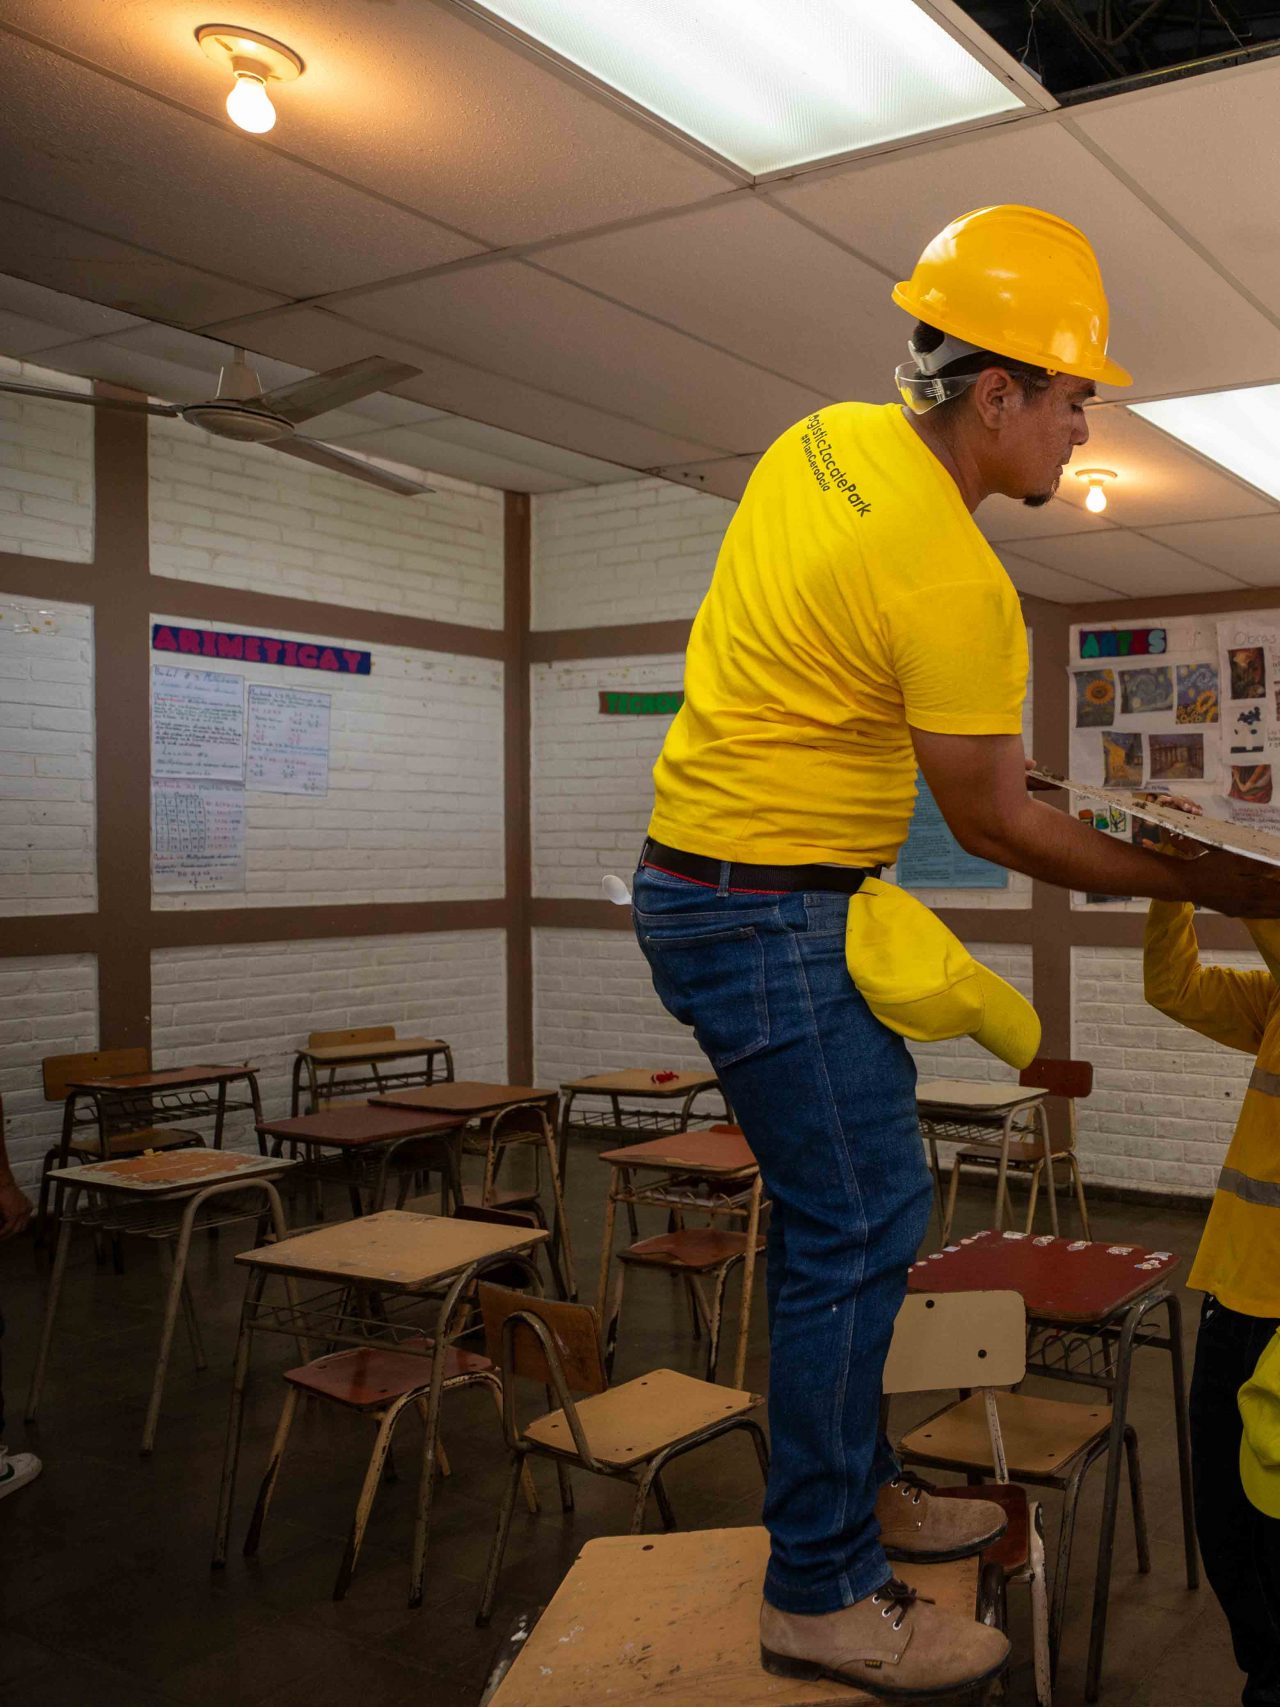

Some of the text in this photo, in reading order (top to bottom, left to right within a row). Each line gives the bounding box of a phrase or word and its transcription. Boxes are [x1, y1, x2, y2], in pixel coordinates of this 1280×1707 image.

[801, 433, 830, 492] #PlanCeroOcio
[1082, 629, 1166, 658] ARTES
[1233, 632, 1276, 646] Obras
